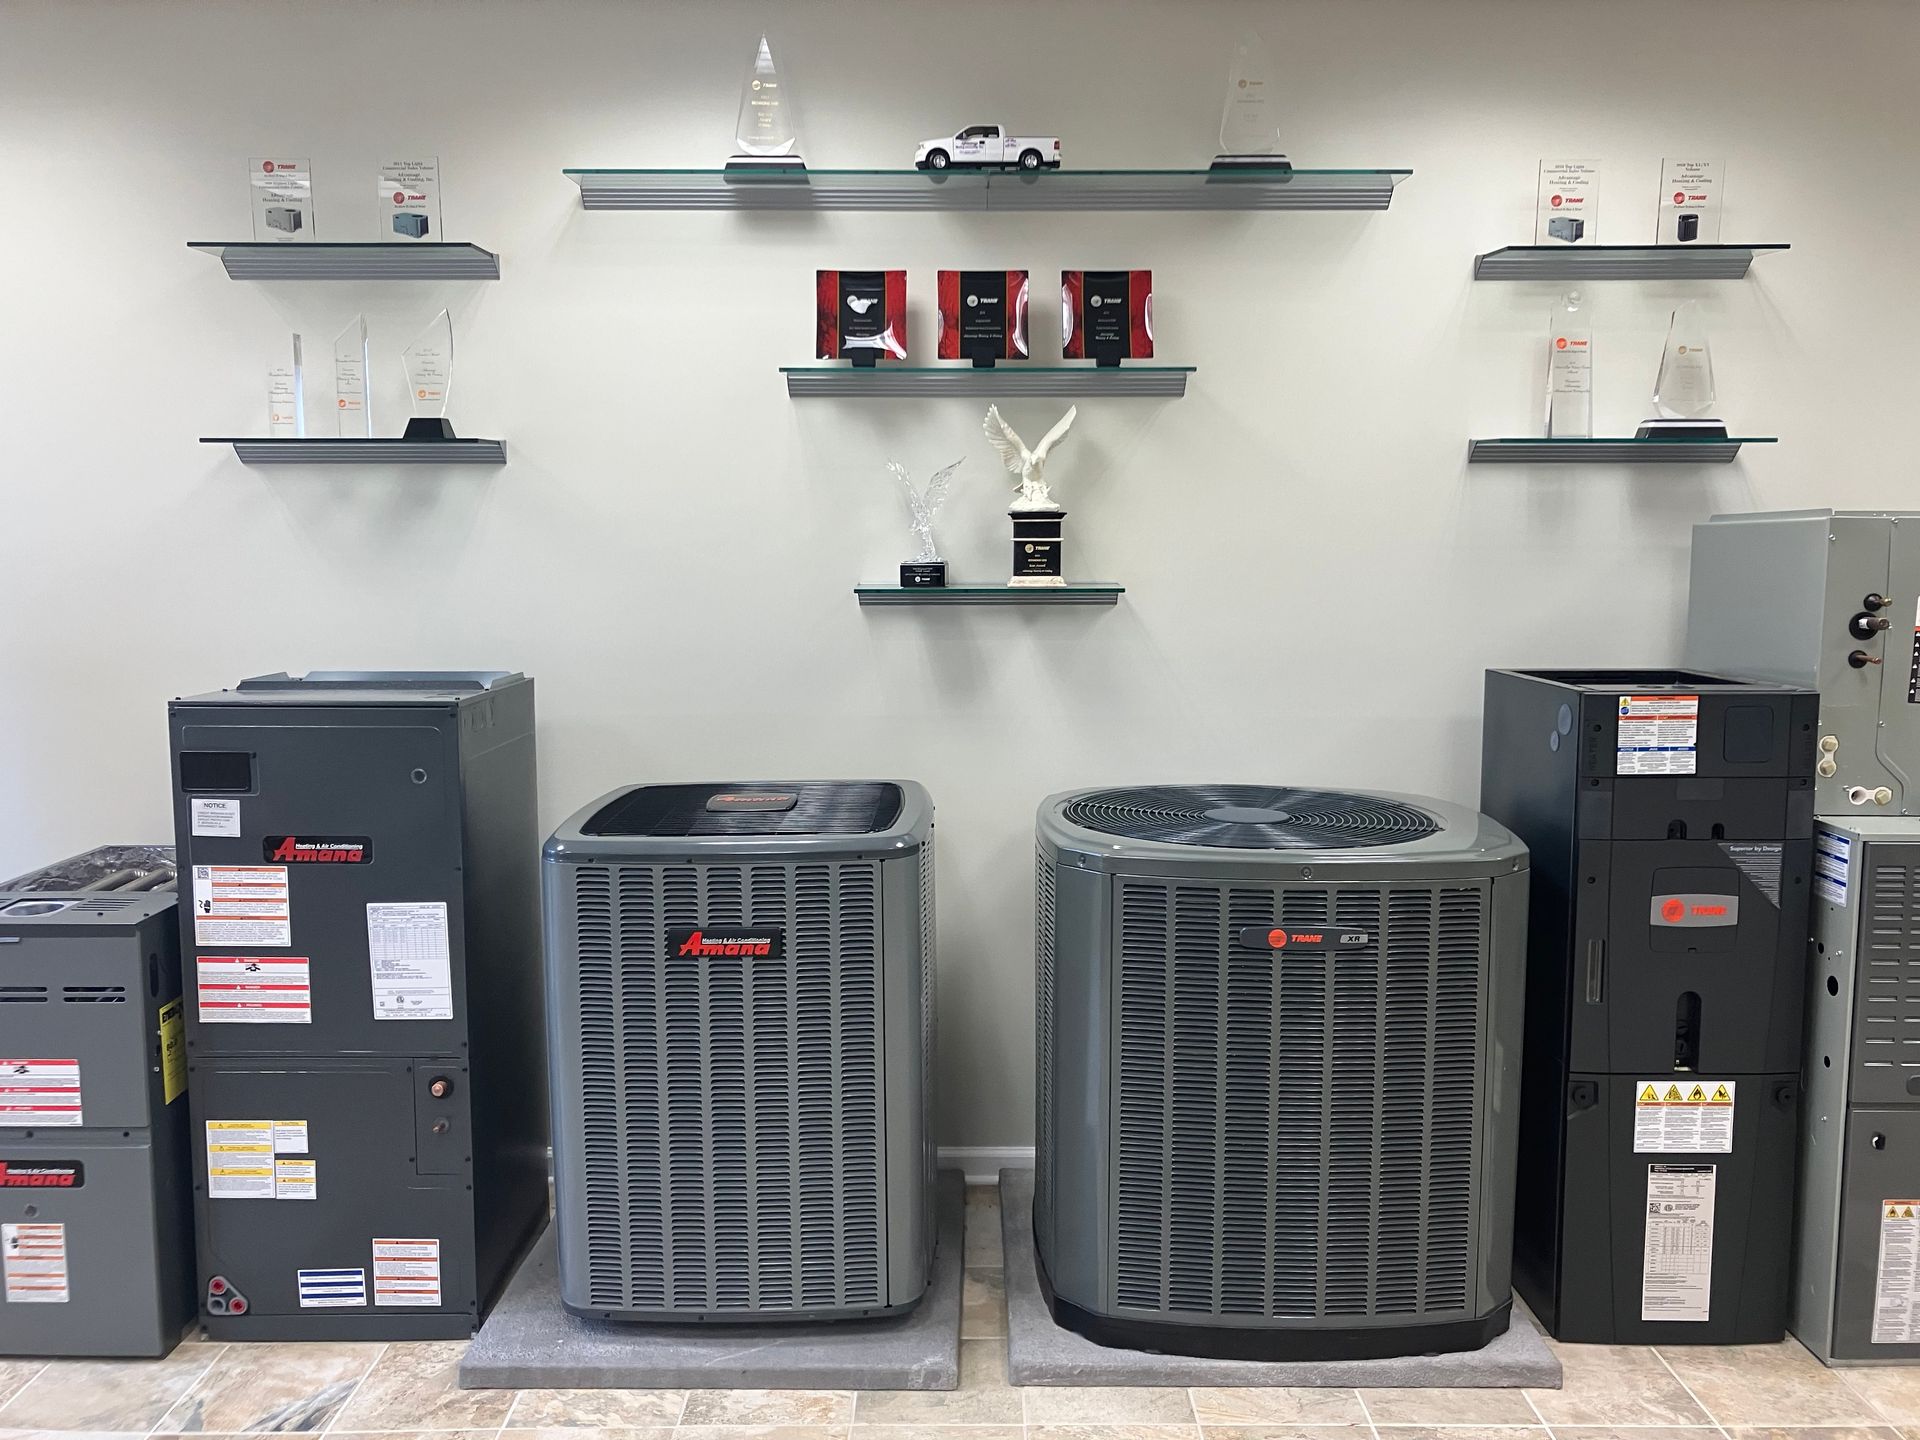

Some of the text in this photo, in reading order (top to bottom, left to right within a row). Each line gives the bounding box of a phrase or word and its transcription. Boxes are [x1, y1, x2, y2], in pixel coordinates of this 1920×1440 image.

[273, 837, 363, 862] Amana
[678, 931, 771, 956] Amana
[1291, 934, 1323, 943] TRANE
